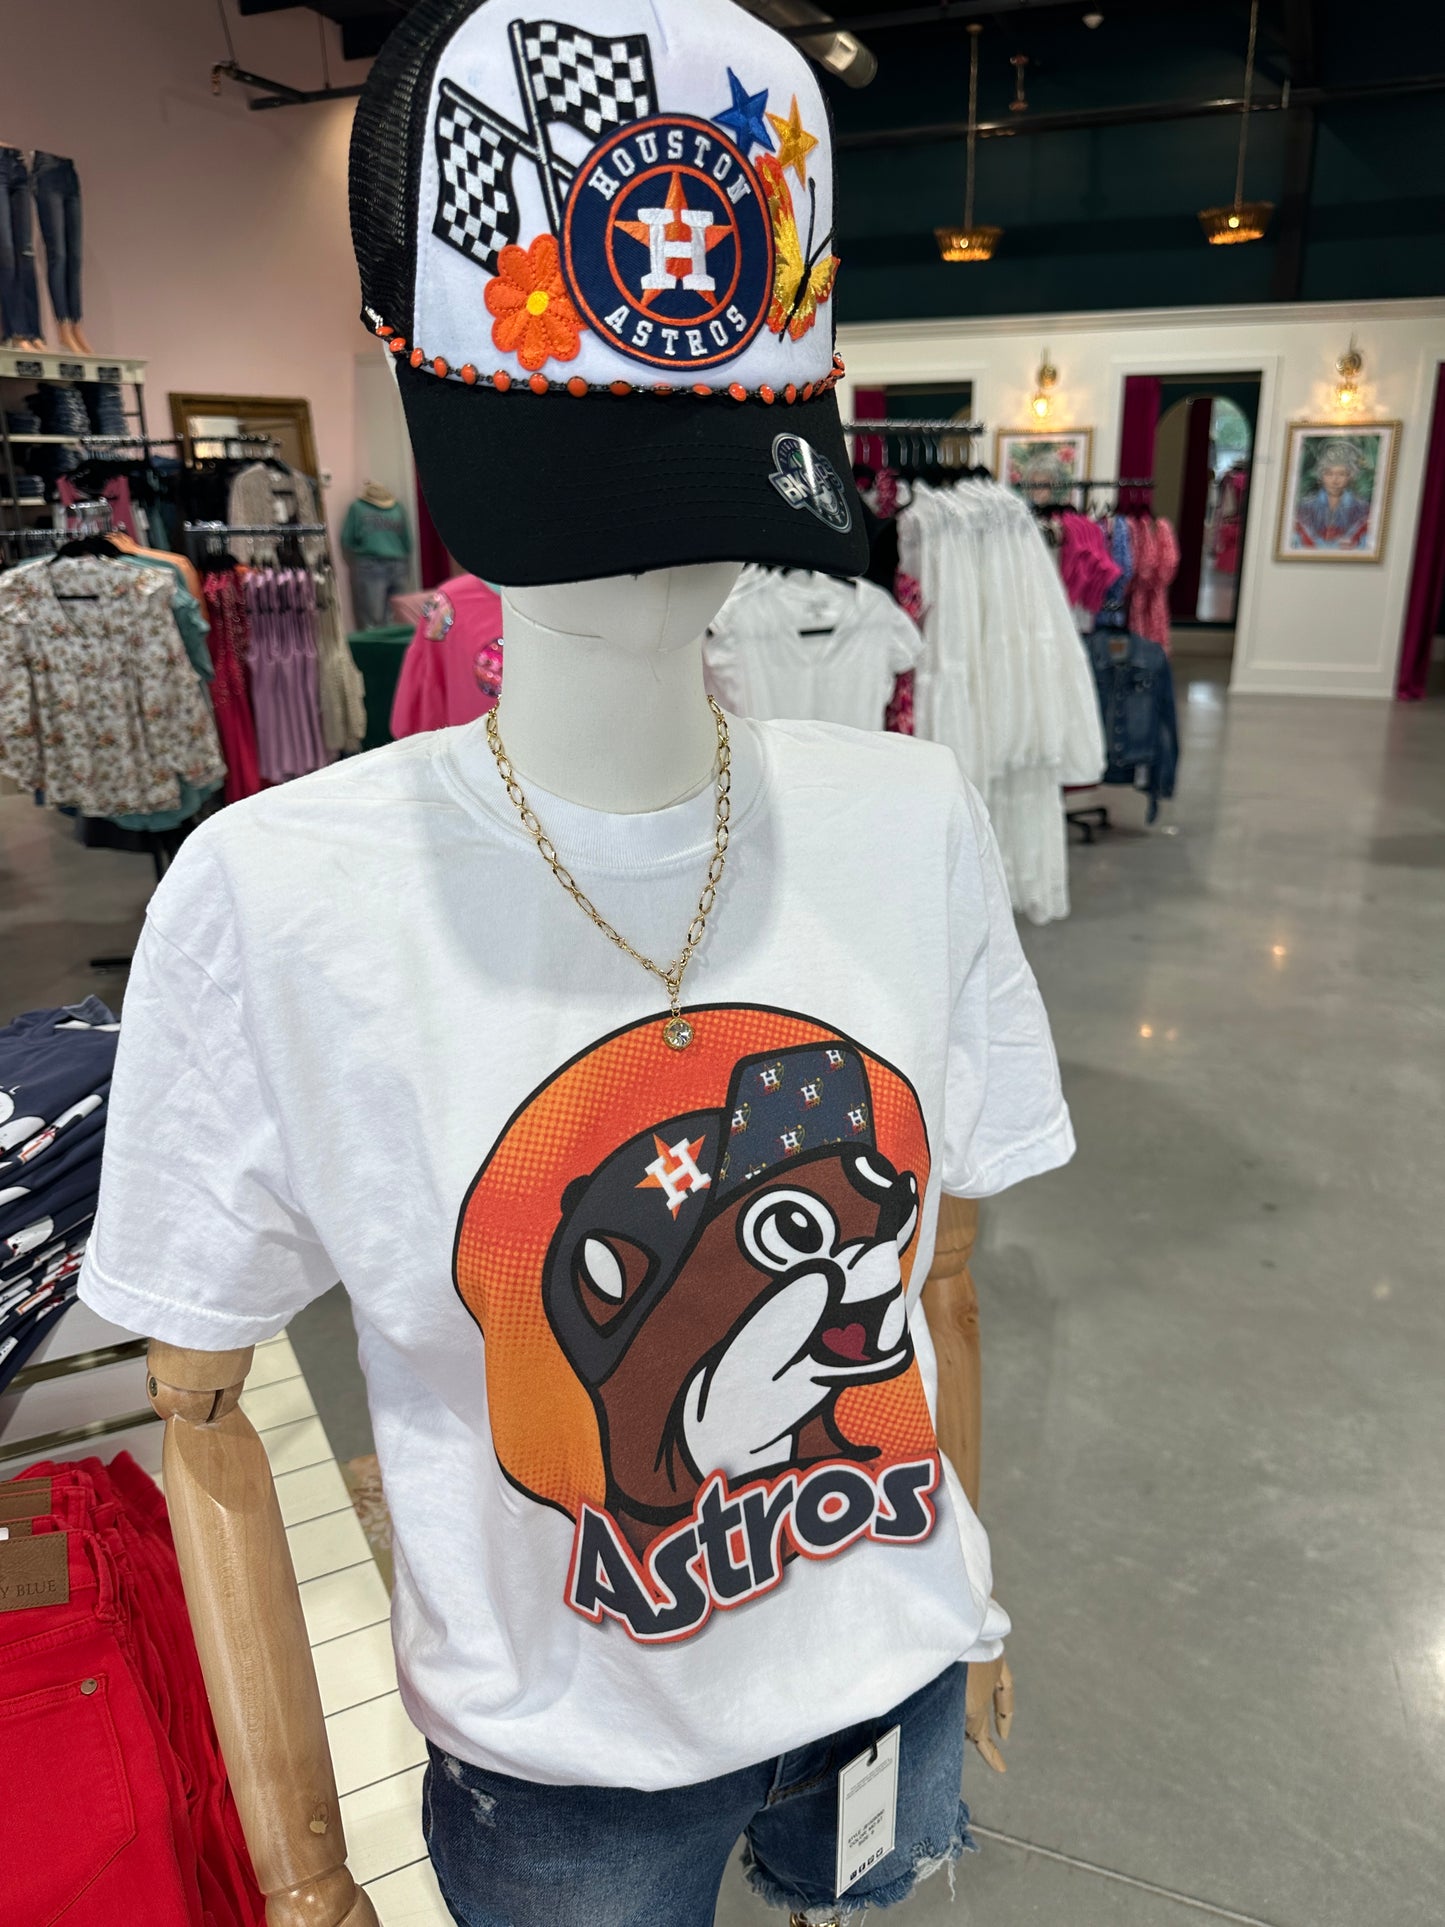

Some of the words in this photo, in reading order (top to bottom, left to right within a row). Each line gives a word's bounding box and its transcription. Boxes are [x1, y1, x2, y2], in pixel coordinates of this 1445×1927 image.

[588, 130, 751, 204] HOUSTON
[637, 207, 716, 291] H
[604, 305, 748, 356] ASTROS
[644, 1137, 712, 1210] H
[566, 1456, 938, 1642] Astros
[16, 1580, 57, 1597] BLUE
